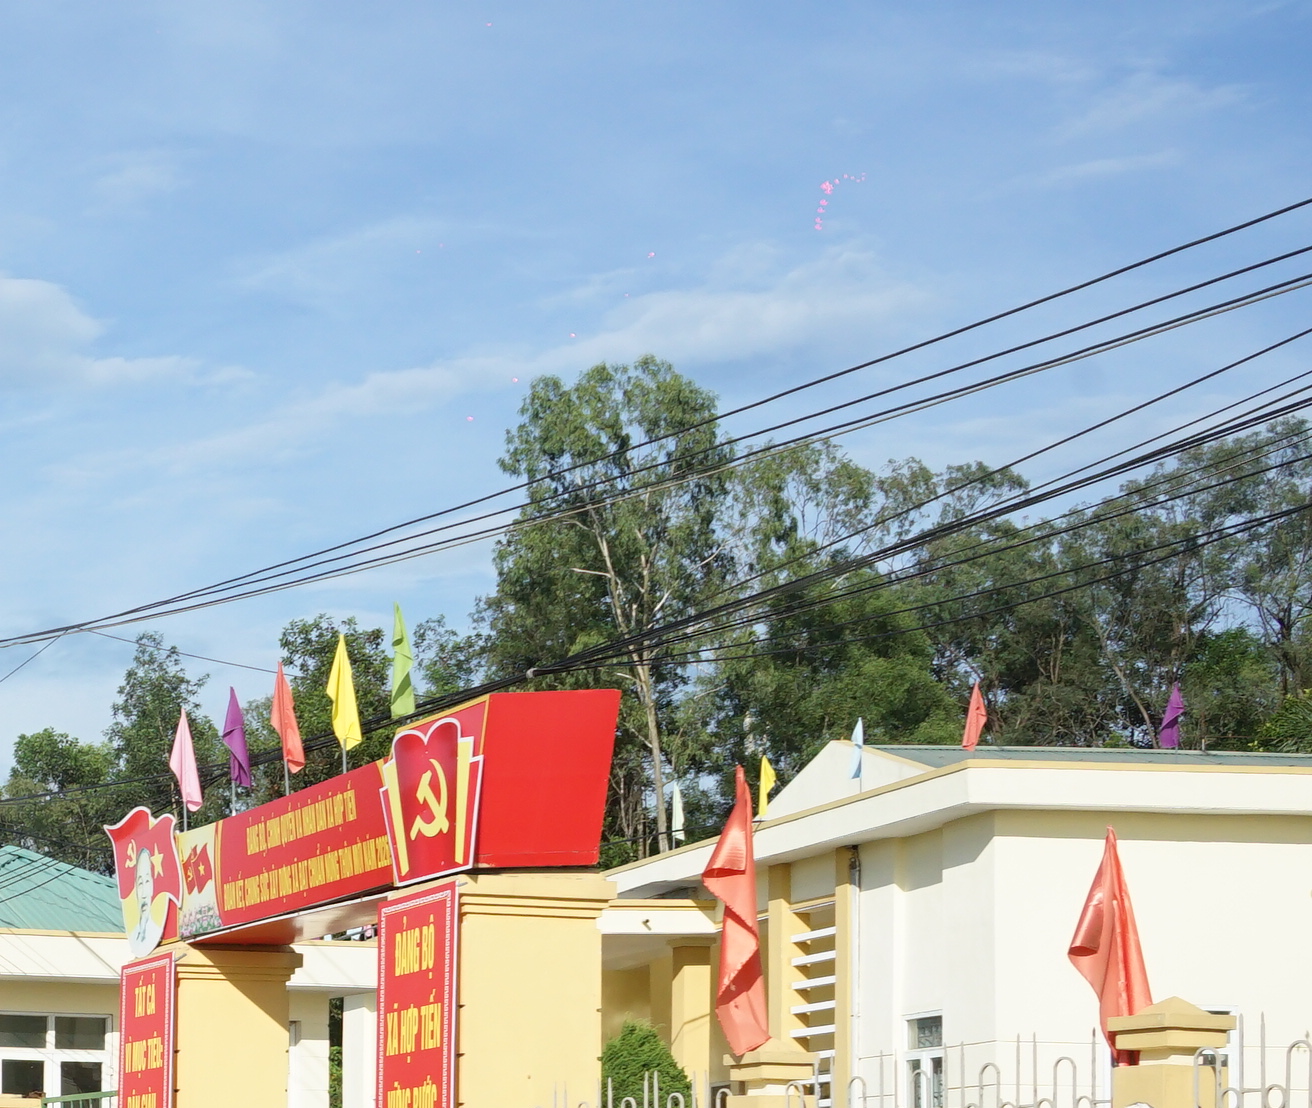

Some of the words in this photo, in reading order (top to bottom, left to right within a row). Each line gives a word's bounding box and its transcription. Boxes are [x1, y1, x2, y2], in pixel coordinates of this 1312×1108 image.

[394, 915, 420, 977] ĐẢNG
[421, 914, 435, 979] BỘ
[134, 975, 147, 1018] TẤT
[146, 973, 156, 1015] CẢ
[386, 1002, 399, 1056] XÃ
[400, 1003, 419, 1063] HỢP
[420, 988, 442, 1051] TIẾN
[125, 1036, 132, 1073] VÌ
[132, 1039, 147, 1079] MỤC
[147, 1031, 164, 1070] TIÊU:
